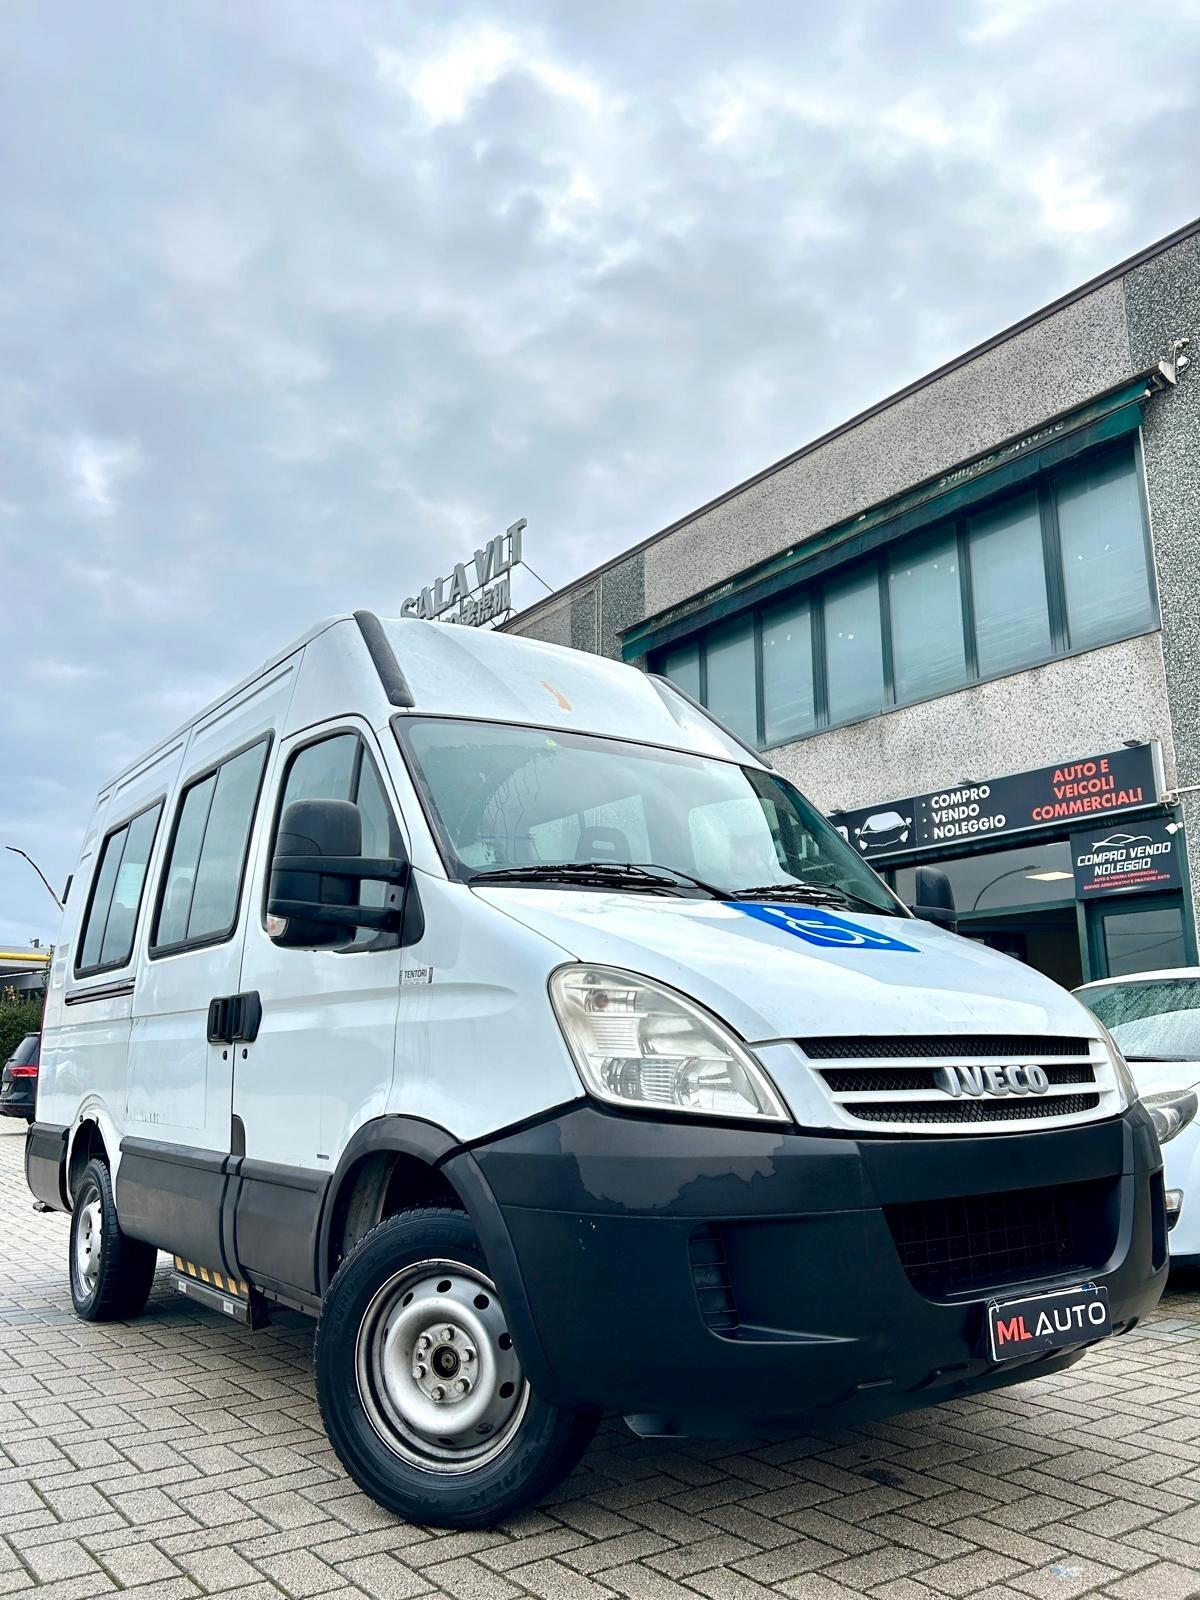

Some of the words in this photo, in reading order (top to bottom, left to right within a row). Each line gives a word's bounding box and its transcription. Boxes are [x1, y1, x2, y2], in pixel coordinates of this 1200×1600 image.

[474, 518, 528, 587] VLT
[1053, 762, 1097, 784] AUTO
[1100, 759, 1110, 773] E
[931, 785, 990, 809] COMPRO
[1053, 775, 1115, 800] VEICOLI
[932, 803, 980, 824] VENDO
[1032, 787, 1142, 820] COMMERCIALI
[933, 814, 1006, 839] NOLEGGIO
[1077, 849, 1126, 866] COMPRO
[1129, 842, 1171, 858] VENDO
[1094, 858, 1151, 876] NOLEGGIO
[404, 969, 428, 979] TENTORI
[933, 1064, 1050, 1098] IVECO
[996, 1316, 1033, 1345] ML
[1035, 1301, 1106, 1337] AUTO
